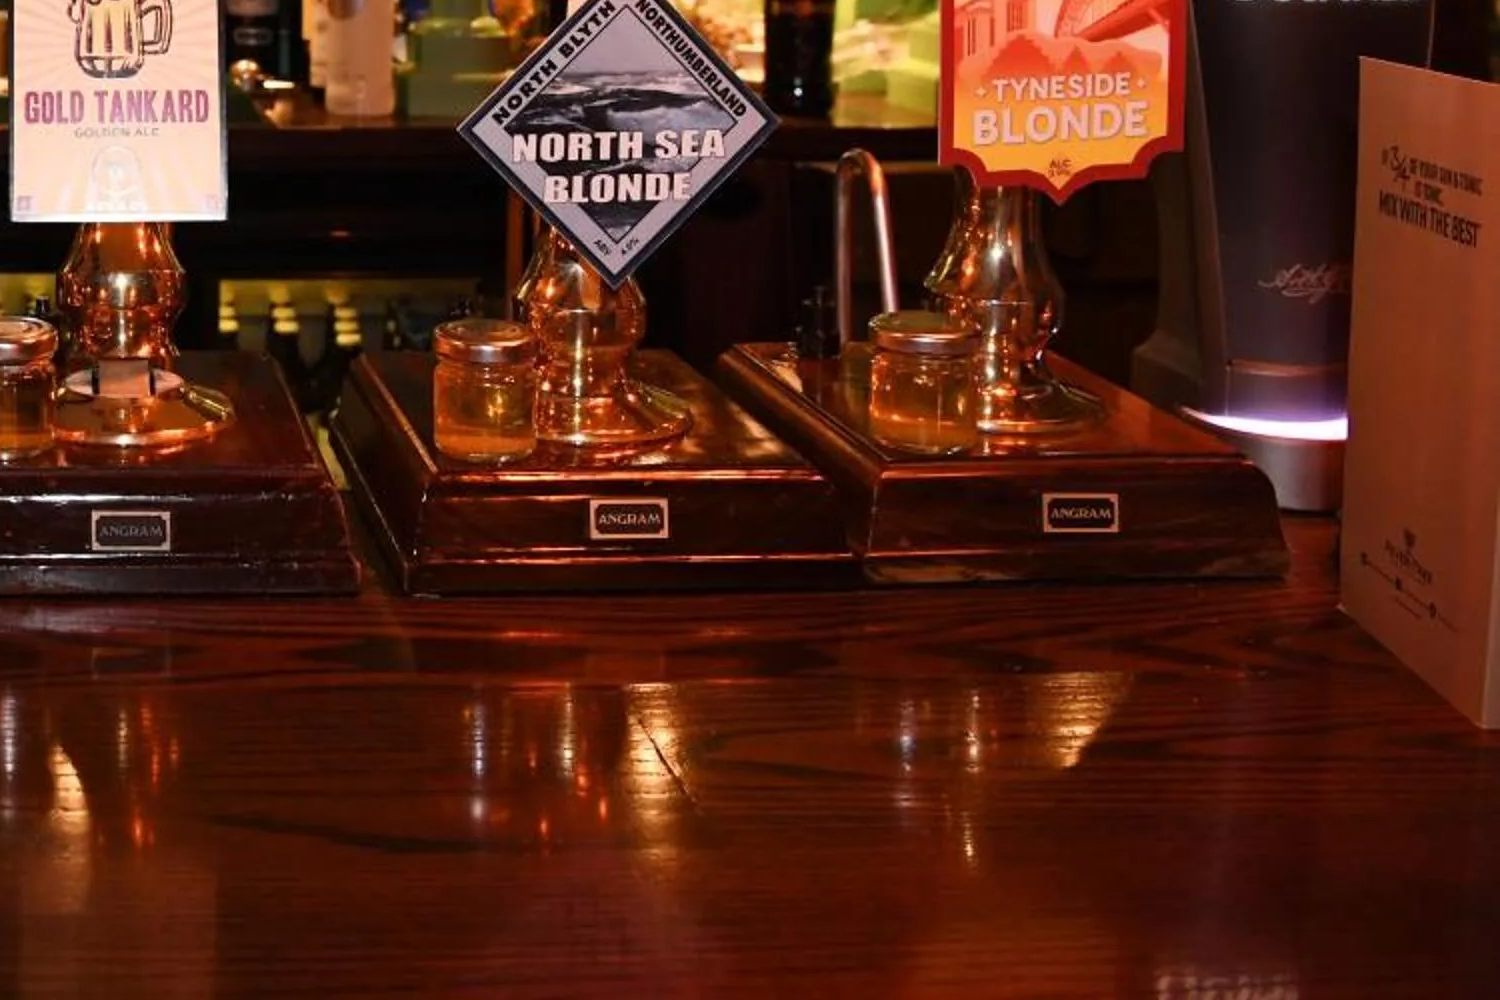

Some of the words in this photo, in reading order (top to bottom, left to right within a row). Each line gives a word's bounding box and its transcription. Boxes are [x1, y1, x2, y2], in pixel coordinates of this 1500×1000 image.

[492, 60, 558, 125] NORTH
[559, 0, 616, 59] BLYTH
[992, 71, 1132, 102] TYNESIDE
[24, 91, 85, 124] GOLD
[94, 89, 209, 124] TANKARD
[972, 100, 1149, 146] BLONDE
[511, 132, 643, 163] NORTH
[655, 128, 726, 159] SEA
[543, 171, 693, 204] BLONDE
[1397, 196, 1427, 230] WITH
[1430, 206, 1451, 239] THE
[1451, 215, 1482, 249] BEST
[598, 513, 661, 525] ANGRAM
[1051, 507, 1112, 519] ANGRAM
[99, 525, 163, 537] ANGRAM
